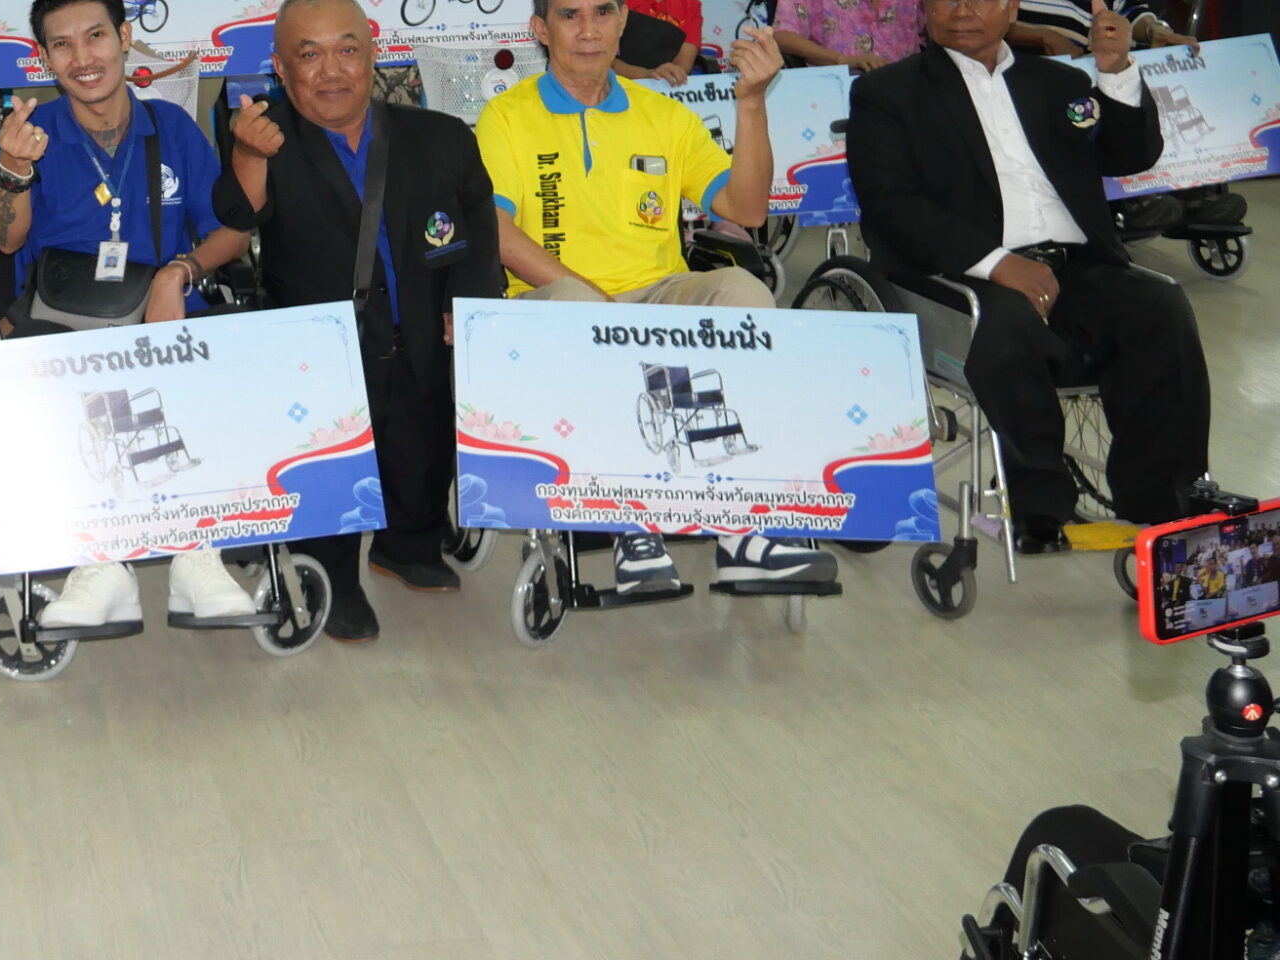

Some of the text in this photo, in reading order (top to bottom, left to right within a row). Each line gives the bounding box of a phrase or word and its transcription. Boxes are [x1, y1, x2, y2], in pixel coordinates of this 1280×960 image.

[534, 151, 566, 262] Dr. Singkham Man
[32, 326, 210, 378] มอบรถเข็นนั่ง
[593, 314, 772, 352] มอบรถเข็นนั่ง
[536, 475, 855, 508] กองทุนฟื้นฟูสมรรถภาพจังหวัดสมุทรปราการ
[552, 503, 842, 530] องค์การบริหารส่วนจังหวัดสมุทรปราการ
